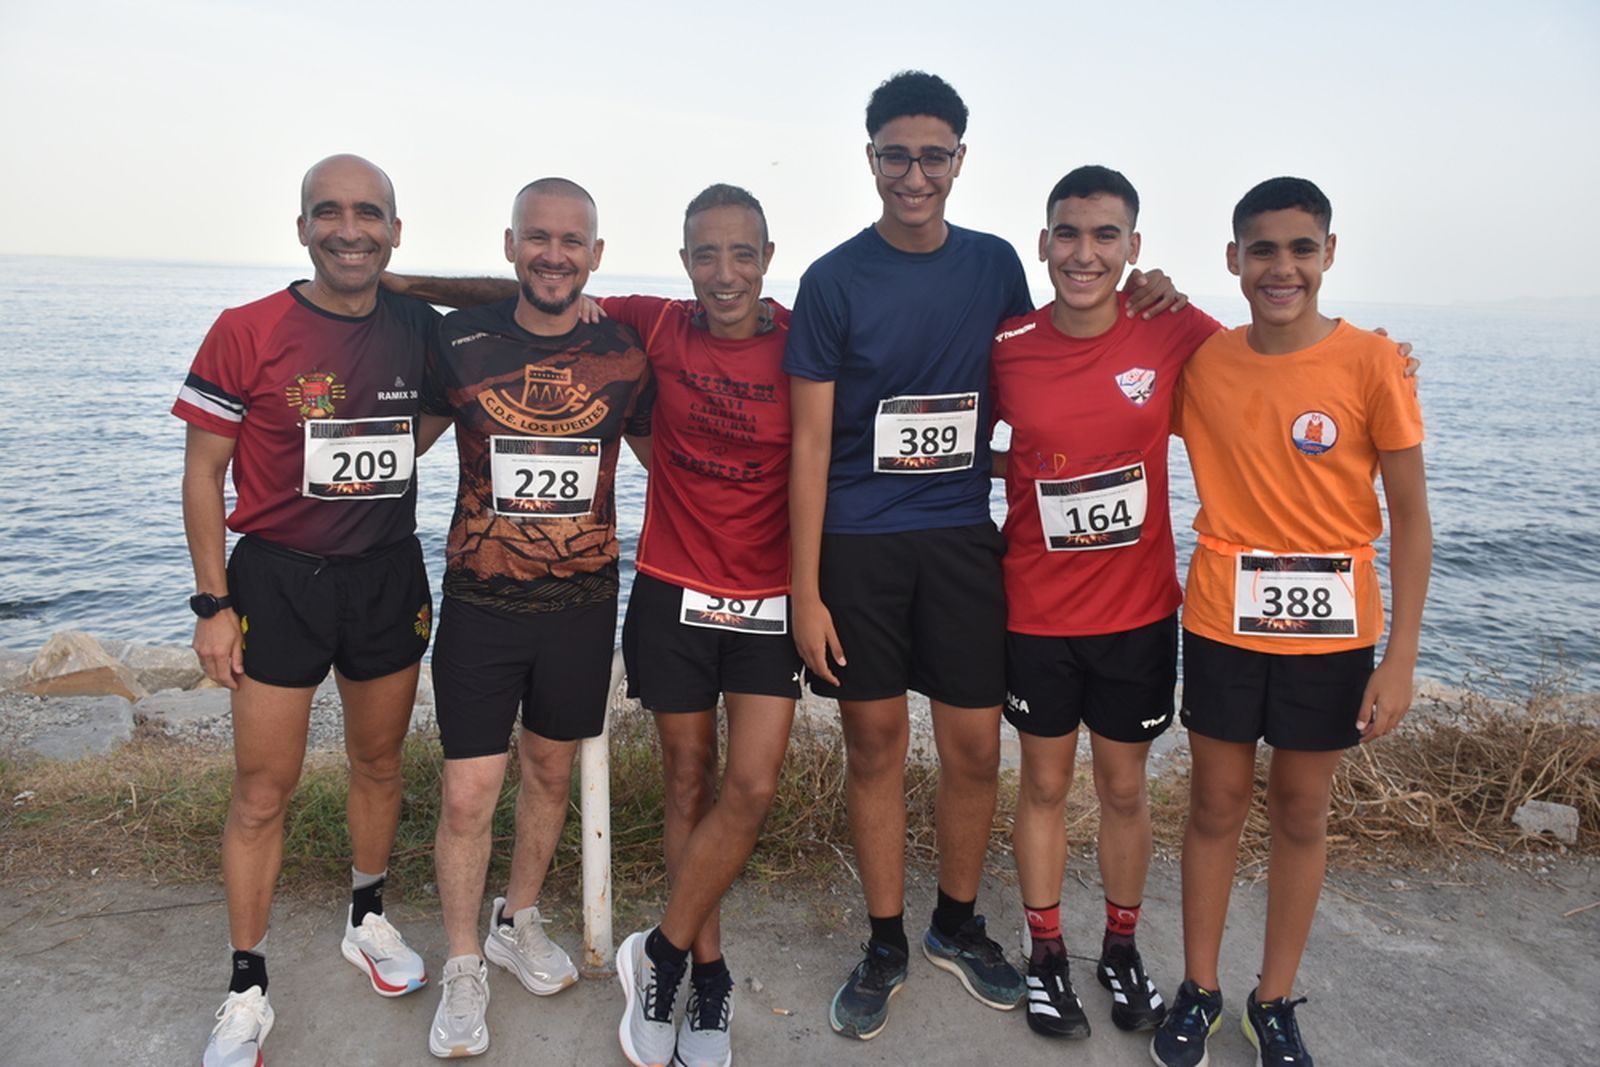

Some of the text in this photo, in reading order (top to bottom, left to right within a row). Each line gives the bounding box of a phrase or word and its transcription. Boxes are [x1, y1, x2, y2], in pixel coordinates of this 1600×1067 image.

[377, 391, 409, 400] RAMIX
[486, 397, 605, 432] C.D.E. LOS FUERTES
[899, 426, 958, 456] 389
[332, 450, 397, 482] 209
[514, 468, 579, 499] 228
[1066, 499, 1132, 534] 164
[1262, 586, 1333, 618] 388
